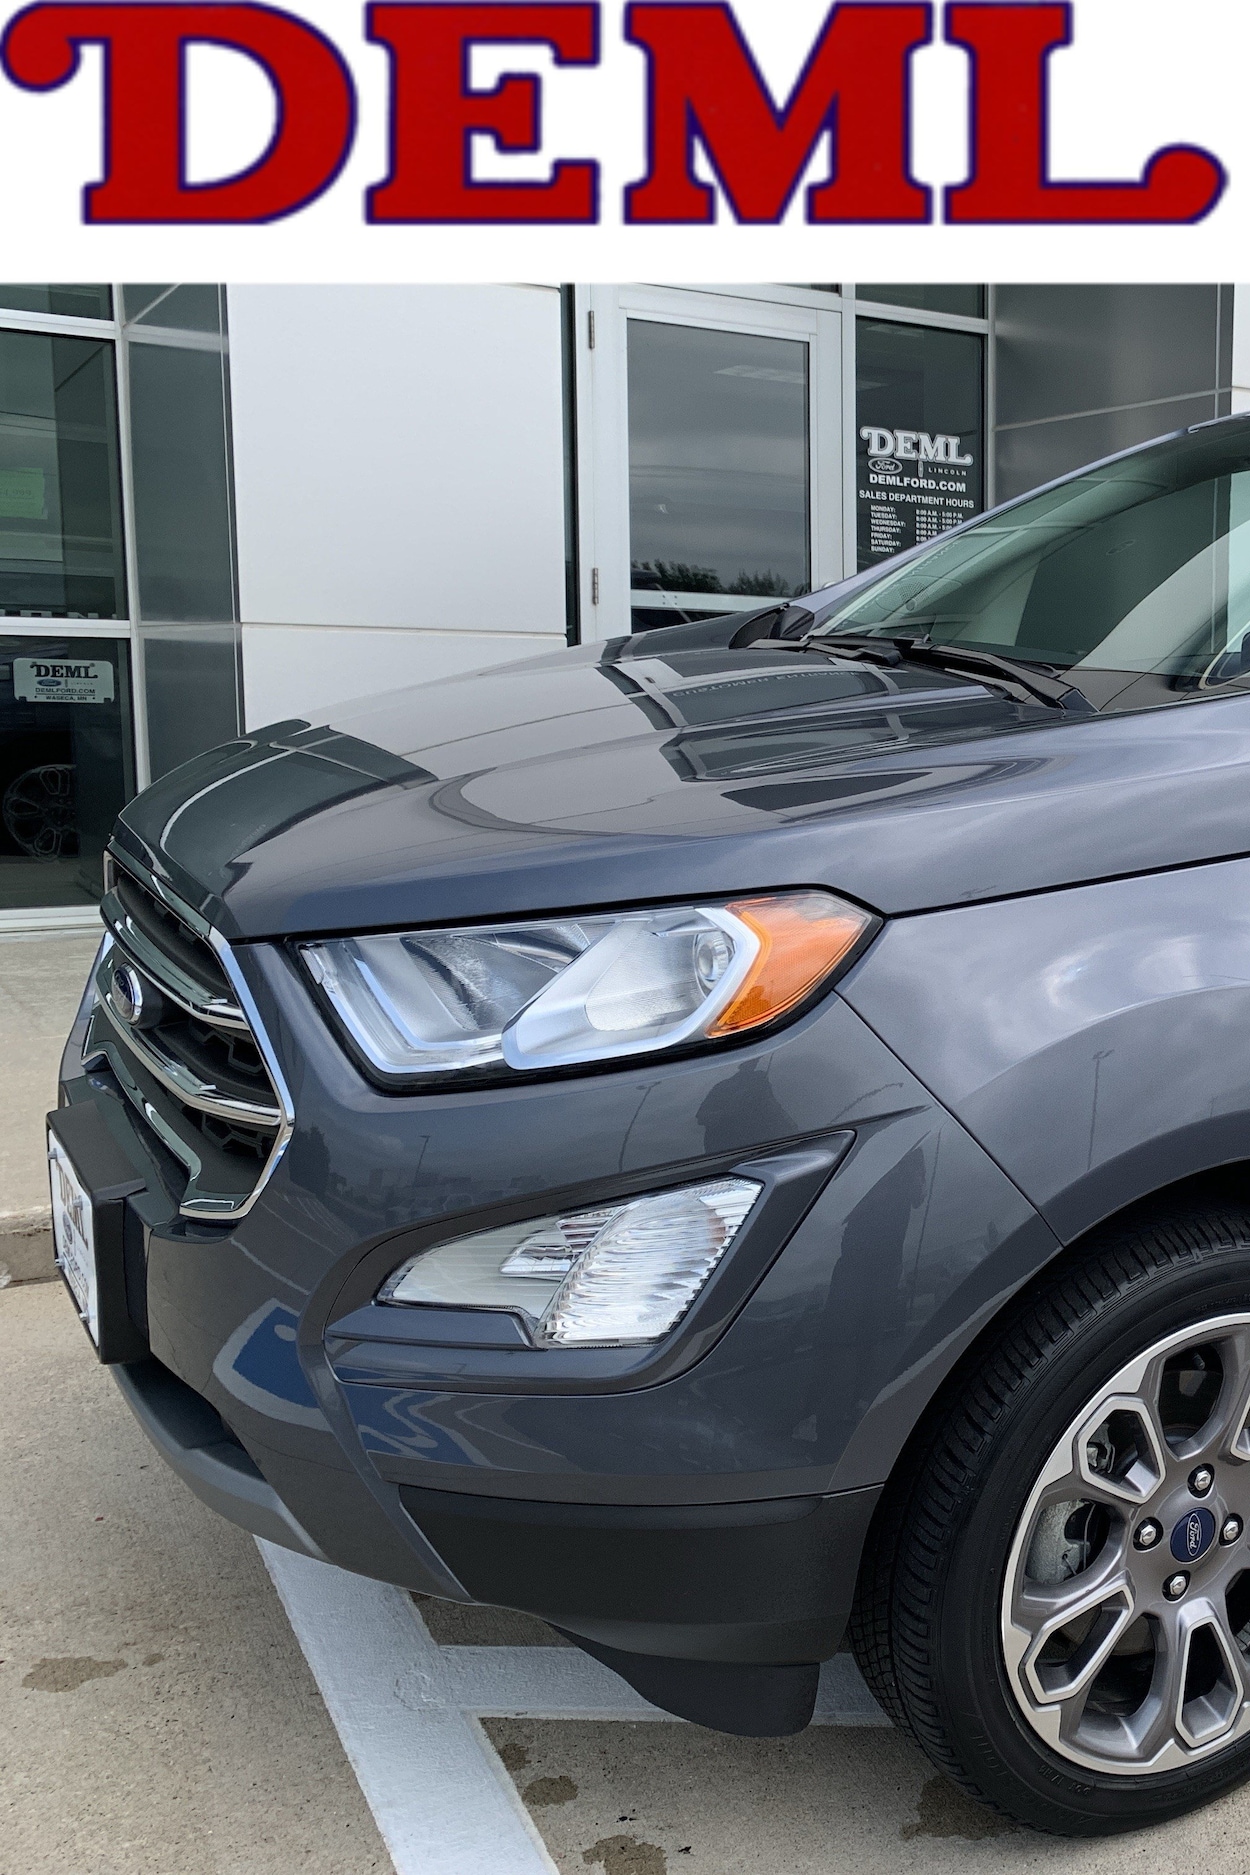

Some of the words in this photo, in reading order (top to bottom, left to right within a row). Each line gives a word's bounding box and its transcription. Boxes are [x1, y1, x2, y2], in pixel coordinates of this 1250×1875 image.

[860, 426, 973, 466] DEML
[928, 467, 967, 476] LINCOLN
[869, 474, 966, 492] DEMLFORD.COM
[859, 489, 887, 501] SALES
[889, 493, 944, 506] DEPARTMENT
[945, 498, 975, 509] HOURS
[30, 664, 98, 679] DEML
